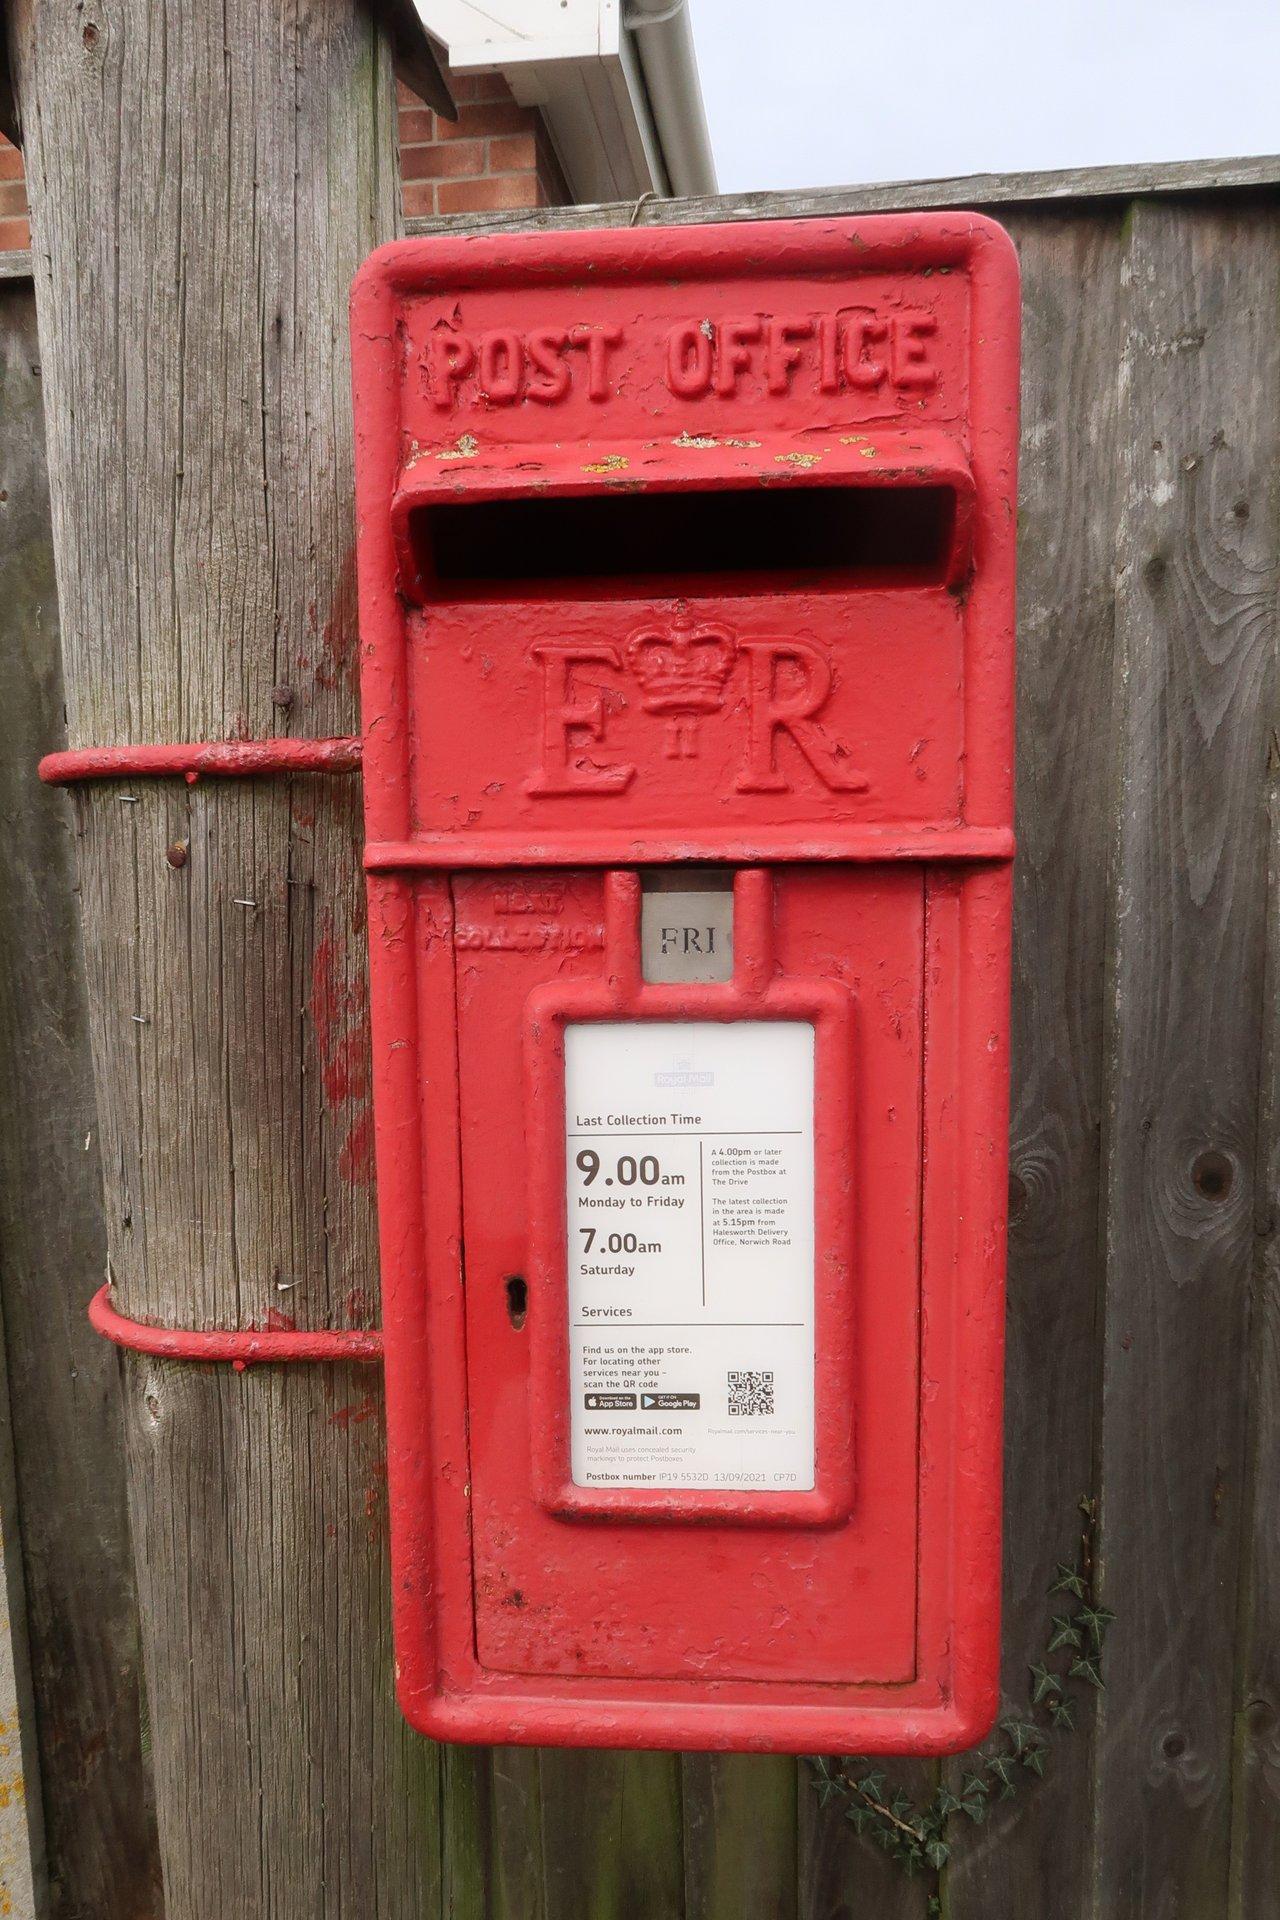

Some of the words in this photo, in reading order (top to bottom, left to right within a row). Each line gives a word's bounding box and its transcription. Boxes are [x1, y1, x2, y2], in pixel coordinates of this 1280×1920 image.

[430, 325, 624, 408] POST
[666, 312, 938, 400] OFFICE
[528, 641, 637, 797] E
[736, 635, 870, 795] R
[660, 927, 716, 955] FRI
[576, 1115, 602, 1127] Last
[607, 1114, 667, 1126] Collection
[671, 1114, 701, 1125] Time
[719, 1147, 751, 1157] 4.00pm
[764, 1148, 782, 1156] later
[576, 1149, 685, 1187] 9.00am
[729, 1178, 748, 1186] Drive
[578, 1197, 625, 1210] Monday
[630, 1197, 642, 1207] to
[647, 1196, 685, 1209] Friday
[722, 1218, 755, 1227] 5.15pm
[758, 1228, 788, 1237] Delivery
[579, 1228, 662, 1254] 7.00am
[773, 1238, 791, 1246] Road
[580, 1264, 635, 1277] Saturday
[582, 1306, 632, 1317] Services
[583, 1346, 601, 1354] Find
[631, 1346, 645, 1354] the
[648, 1347, 664, 1355] app
[583, 1358, 597, 1366] For
[600, 1357, 634, 1367] locating
[637, 1357, 661, 1365] other
[583, 1369, 618, 1377] services
[644, 1370, 660, 1378] you
[606, 1380, 620, 1388] the
[623, 1380, 636, 1388] QR
[638, 1380, 658, 1388] code
[599, 1400, 614, 1408] App
[658, 1400, 682, 1408] Google
[683, 1400, 697, 1408] Play
[584, 1426, 683, 1437] www.royalmail.com
[586, 1446, 605, 1454] Royal
[671, 1446, 696, 1454] security
[587, 1455, 617, 1463] markings
[626, 1455, 649, 1463] protect
[586, 1472, 620, 1481] Postbox
[659, 1473, 678, 1481] IP19
[714, 1472, 766, 1482] 13/09/2021
[773, 1473, 797, 1482] CP7D
